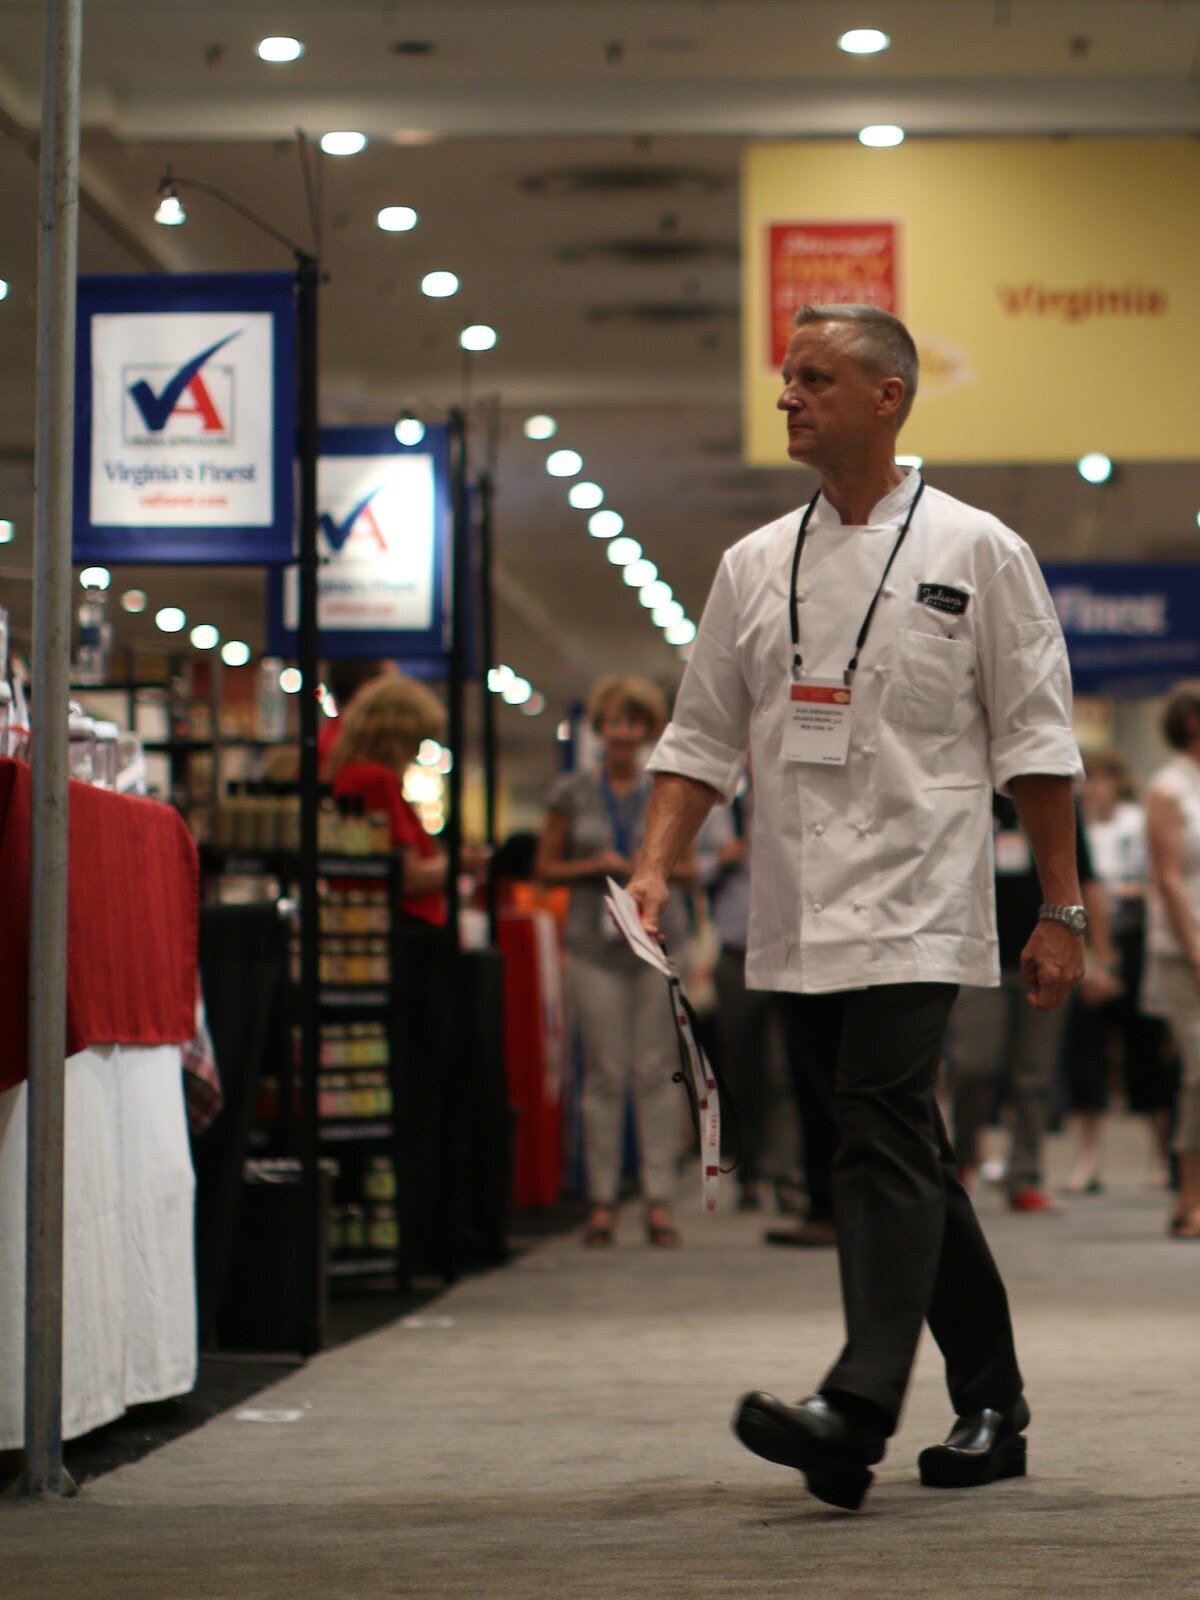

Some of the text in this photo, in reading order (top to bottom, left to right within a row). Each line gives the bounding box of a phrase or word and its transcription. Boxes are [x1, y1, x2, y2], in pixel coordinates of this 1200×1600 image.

[996, 280, 1169, 325] Virginia
[104, 461, 255, 488] Virginia's Finest
